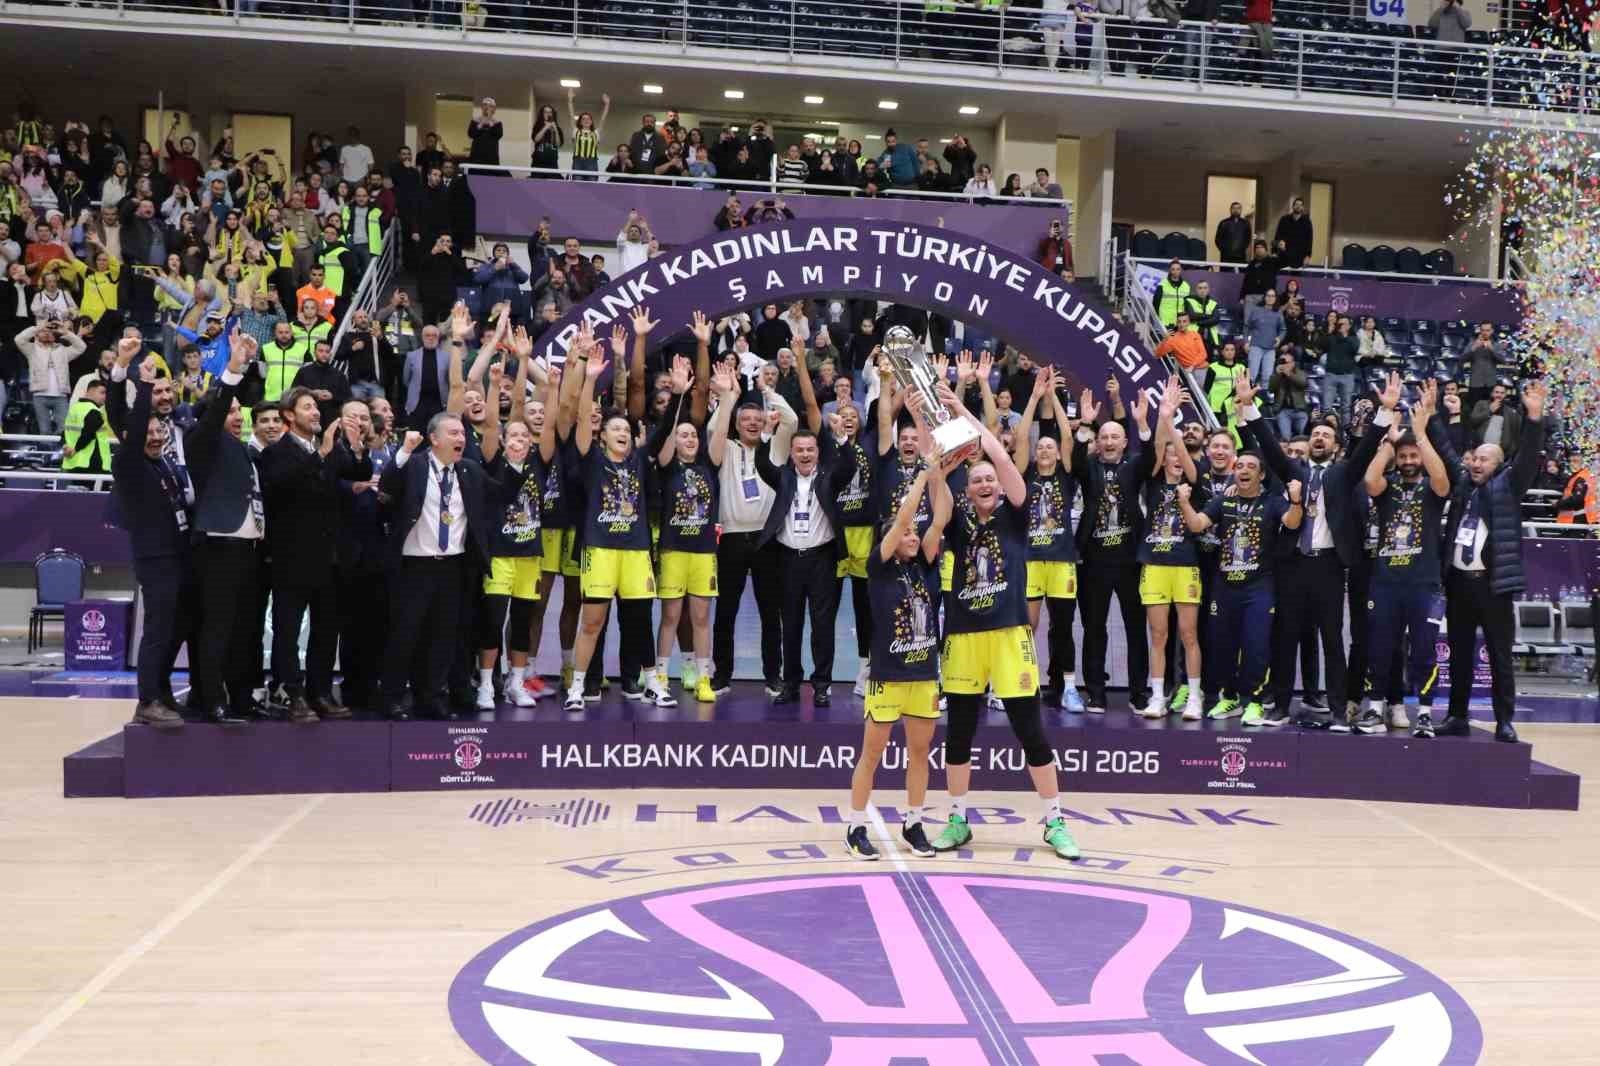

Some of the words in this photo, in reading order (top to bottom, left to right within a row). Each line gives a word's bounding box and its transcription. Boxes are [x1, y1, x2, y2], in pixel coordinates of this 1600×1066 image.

[1369, 0, 1405, 17] G4
[728, 265, 990, 317] ŞAMPİYON
[659, 227, 858, 286] KADINLAR
[871, 226, 1032, 293] TÜRKİYE
[1033, 278, 1151, 383] KUPASI
[608, 522, 632, 533] 2026
[958, 581, 1009, 601] Champions
[968, 596, 994, 611] 2026
[904, 648, 929, 664] 2026
[541, 743, 704, 769] HALKBANK
[711, 744, 856, 769] KADINLAR
[882, 740, 982, 771] ÜKİE
[989, 747, 1088, 773] KUASI
[1095, 750, 1160, 774] 2026
